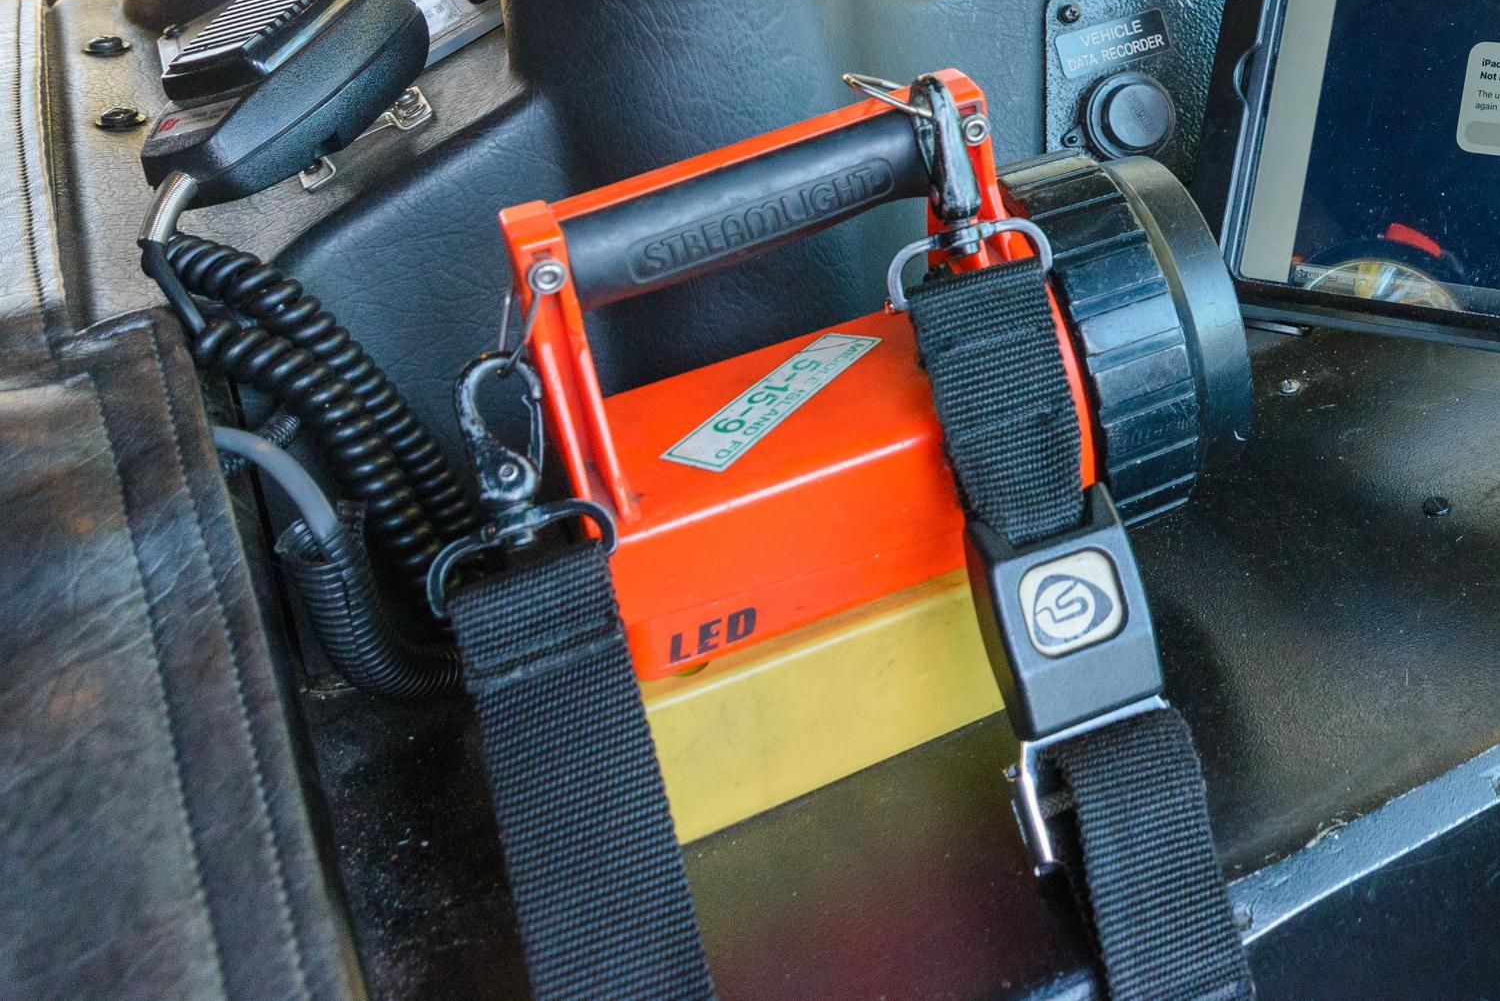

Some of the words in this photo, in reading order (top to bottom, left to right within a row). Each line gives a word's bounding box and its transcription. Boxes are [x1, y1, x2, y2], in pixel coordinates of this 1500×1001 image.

[1080, 19, 1144, 47] VEHICLE
[1067, 53, 1098, 72] DATA
[1101, 34, 1165, 63] RECORDER
[1480, 72, 1497, 81] Not
[1474, 102, 1498, 112] again
[1478, 90, 1493, 99] The
[712, 357, 822, 435] 5-15-9
[742, 388, 806, 438] ISLAND
[713, 439, 743, 461] FD
[669, 605, 758, 665] LED
